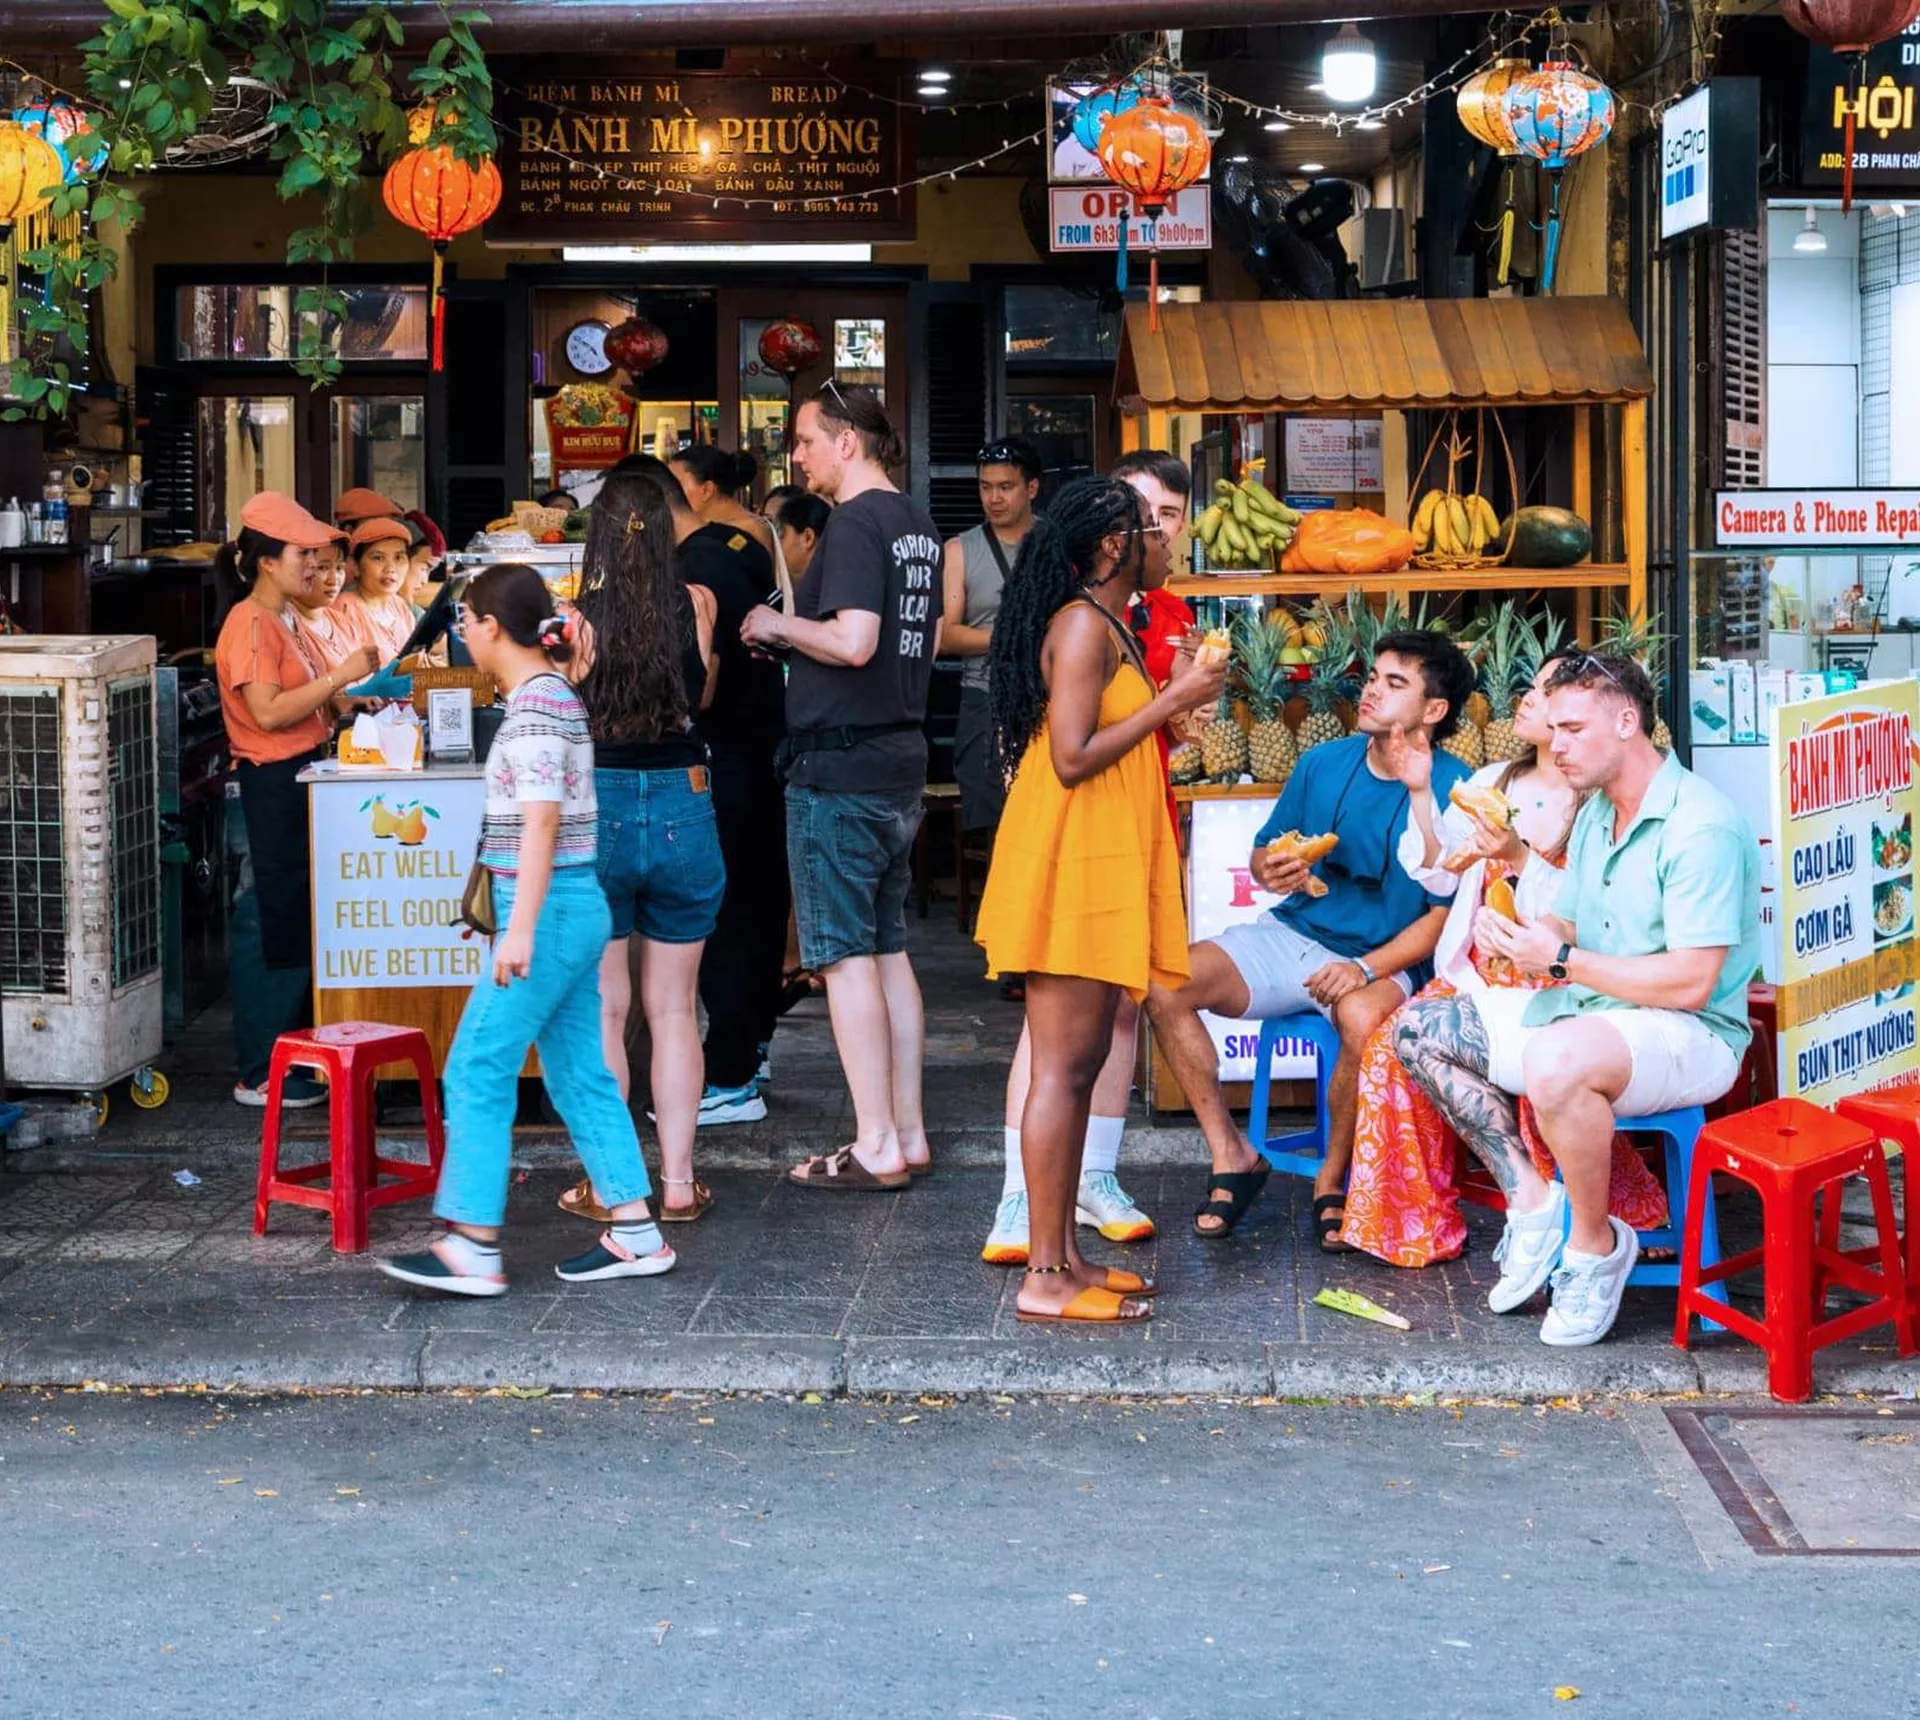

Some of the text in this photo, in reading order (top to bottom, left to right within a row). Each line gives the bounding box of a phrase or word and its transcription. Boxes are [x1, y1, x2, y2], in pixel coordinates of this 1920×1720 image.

[771, 86, 838, 102] BREAD
[1833, 75, 1914, 139] HỘI
[718, 111, 881, 160] PHƯỢNG
[1667, 129, 1705, 168] GoPro
[799, 162, 830, 176] THỊT
[1851, 153, 1868, 169] 2B
[1871, 153, 1900, 169] PHAN
[715, 176, 755, 191] BÁNH
[803, 179, 844, 191] XANH
[639, 202, 671, 213] TRINH
[1058, 224, 1091, 244] FROM
[1141, 224, 1156, 243] TO
[1159, 223, 1204, 245] 9h00pm
[1721, 500, 1786, 533] Camera
[1793, 501, 1806, 533] &
[1813, 501, 1867, 533] Phone
[1789, 709, 1911, 816] BÁNH MÌ PHƯỢNG
[340, 850, 462, 880] EAT WELL
[1794, 825, 1854, 886] CAO LẦU
[335, 899, 394, 929] FEEL
[1795, 896, 1853, 954] CƠM GÀ
[325, 947, 481, 979] LIVE BETTER
[1798, 1010, 1915, 1090] BÚN THỊT NƯỚNG
